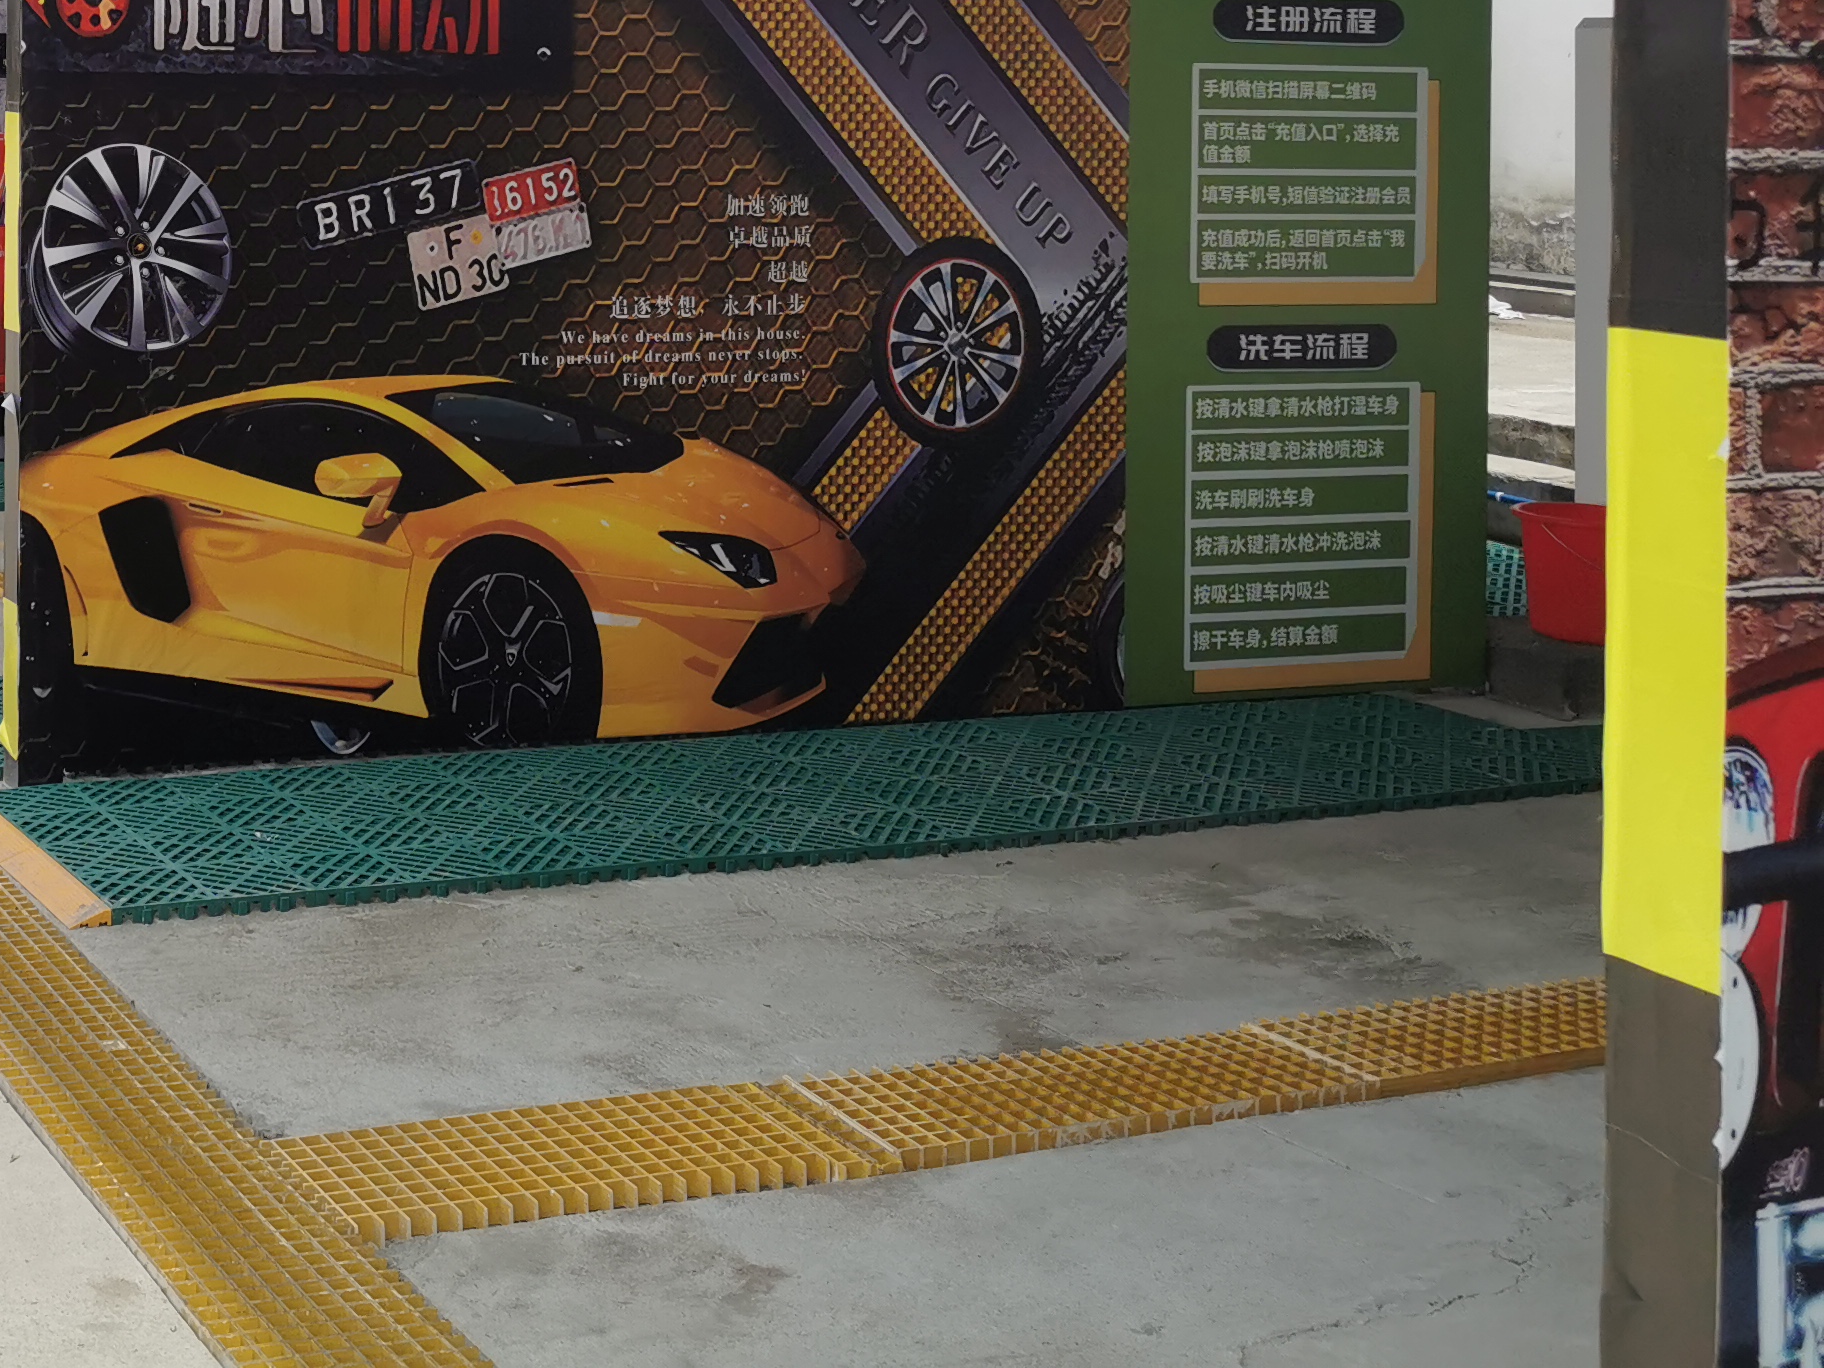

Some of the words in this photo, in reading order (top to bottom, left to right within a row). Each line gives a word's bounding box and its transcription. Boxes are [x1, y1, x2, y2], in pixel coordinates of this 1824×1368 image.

[1246, 5, 1377, 35] 注册流程
[1203, 79, 1377, 101] 手机微信扫描屏幕二维码
[925, 73, 1019, 190] GIVE
[1015, 180, 1074, 250] UP
[1202, 145, 1251, 164] 值金额
[727, 194, 810, 217] 加速领跑
[443, 224, 464, 261] F
[728, 225, 812, 248] 卓越品质
[767, 261, 809, 282] 超越
[561, 331, 585, 344] We
[592, 330, 629, 344] have
[635, 329, 693, 343] dreams
[699, 328, 714, 342] in
[721, 327, 750, 341] this
[756, 326, 806, 340] house.
[1239, 333, 1369, 361] 洗车流程
[520, 352, 550, 366] The
[556, 351, 616, 369] pursuit
[622, 350, 640, 364] of
[644, 349, 702, 363] dreams
[708, 351, 753, 362] never
[757, 349, 804, 365] stops.
[622, 373, 665, 390] Fight
[671, 371, 696, 386] for
[701, 373, 738, 388] your
[743, 369, 807, 385] dreams!
[1196, 395, 1399, 419] 按清水键拿清水枪打湿车身
[1196, 438, 1384, 463] 按泡沫键拿泡沫枪喷泡沫
[1195, 487, 1315, 511] 洗车刷刷洗车身
[1195, 530, 1382, 557] 按清水键清水枪冲洗泡沫
[1193, 580, 1330, 606] 按吸尘键车内吸尘
